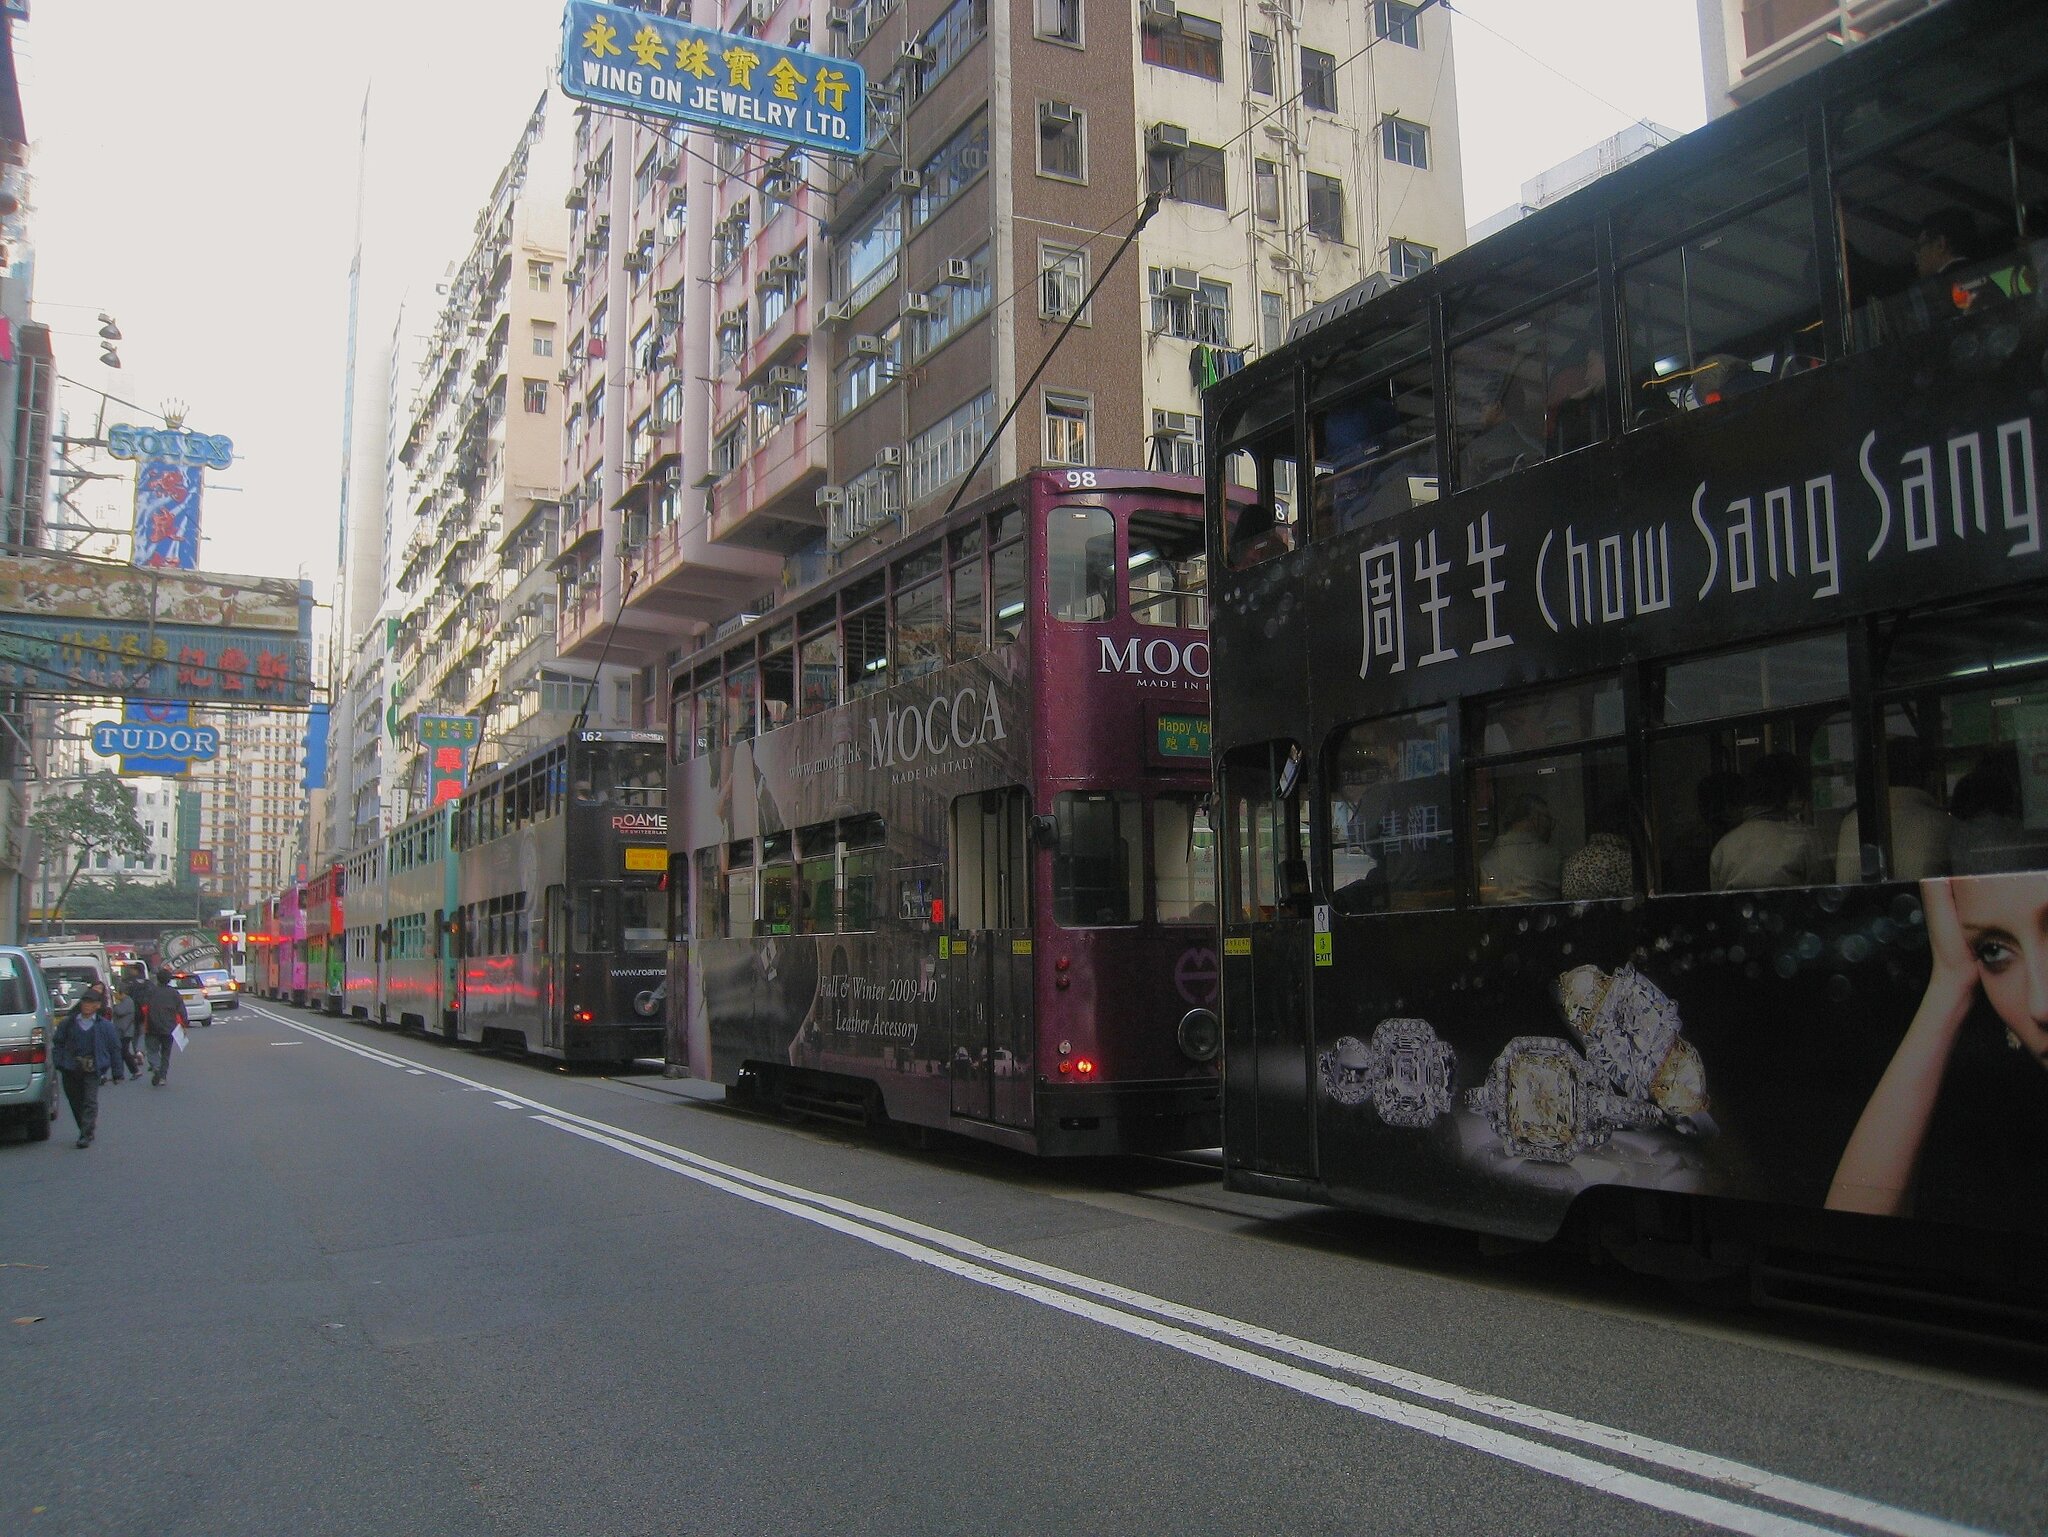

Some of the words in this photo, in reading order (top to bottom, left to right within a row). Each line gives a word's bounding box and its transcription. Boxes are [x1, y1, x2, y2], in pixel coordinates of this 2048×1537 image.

[582, 14, 851, 113] 永安珠寶金行
[582, 60, 642, 96] WING
[650, 75, 682, 104] ON
[689, 85, 797, 129] JEWELRY
[805, 110, 851, 141] LTD.
[1066, 471, 1097, 488] 98
[1536, 521, 1671, 633] Chow
[1691, 474, 1841, 602] Sang
[1859, 417, 2040, 562] Sang
[1359, 511, 1514, 680] 周生生
[1136, 679, 1178, 689] MADE
[1184, 682, 1199, 690] IN
[581, 731, 602, 742] 162
[869, 680, 1007, 771] MOCCA
[1158, 718, 1191, 736] Happy
[97, 728, 216, 753] TUDOR
[891, 768, 921, 786] MADE
[924, 764, 938, 778] IN
[943, 756, 976, 774] ITALY
[1315, 952, 1331, 962] EXIT
[820, 974, 839, 998] Fall
[853, 976, 886, 1001] Winter
[888, 978, 937, 1003] 2009-10
[836, 1009, 870, 1034] Leather
[872, 1012, 919, 1047] Accessory
